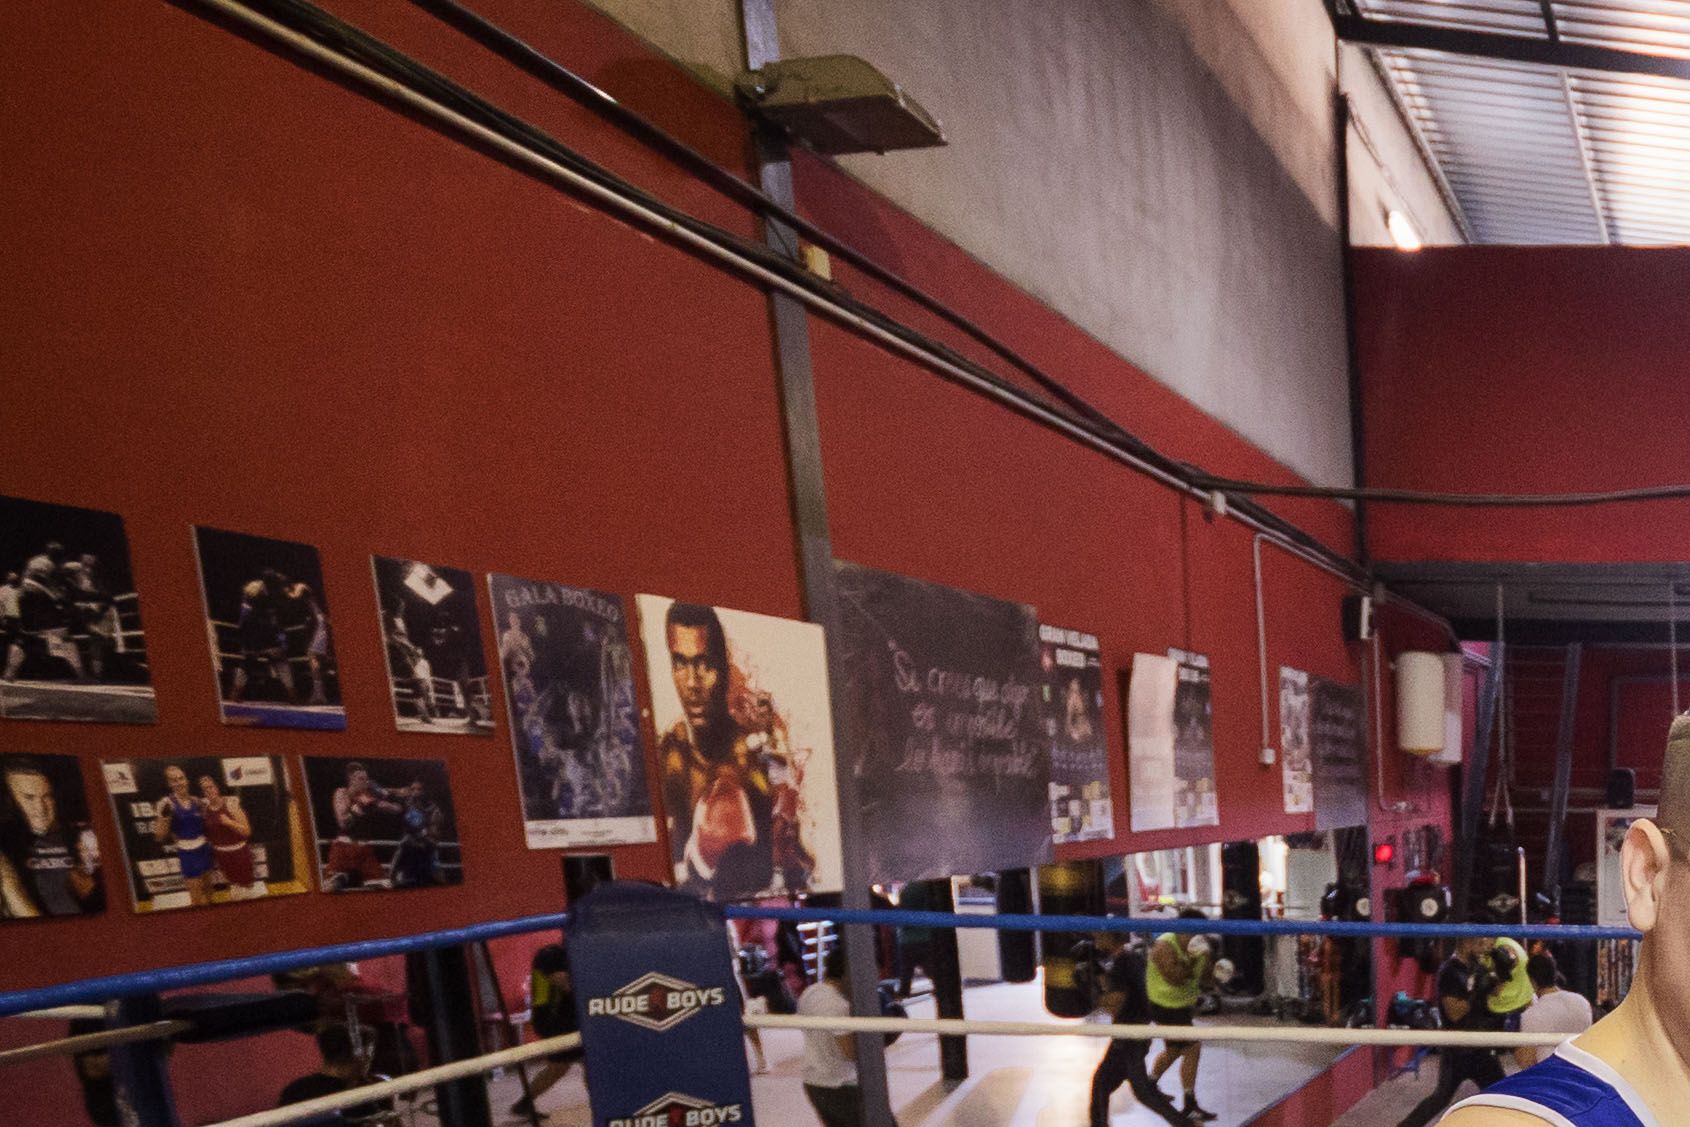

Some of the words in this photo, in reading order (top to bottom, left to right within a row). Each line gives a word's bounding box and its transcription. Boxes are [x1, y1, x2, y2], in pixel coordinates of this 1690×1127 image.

[589, 995, 649, 1016] RUDE
[667, 988, 725, 1010] BOYS
[686, 1104, 742, 1127] BOYS
